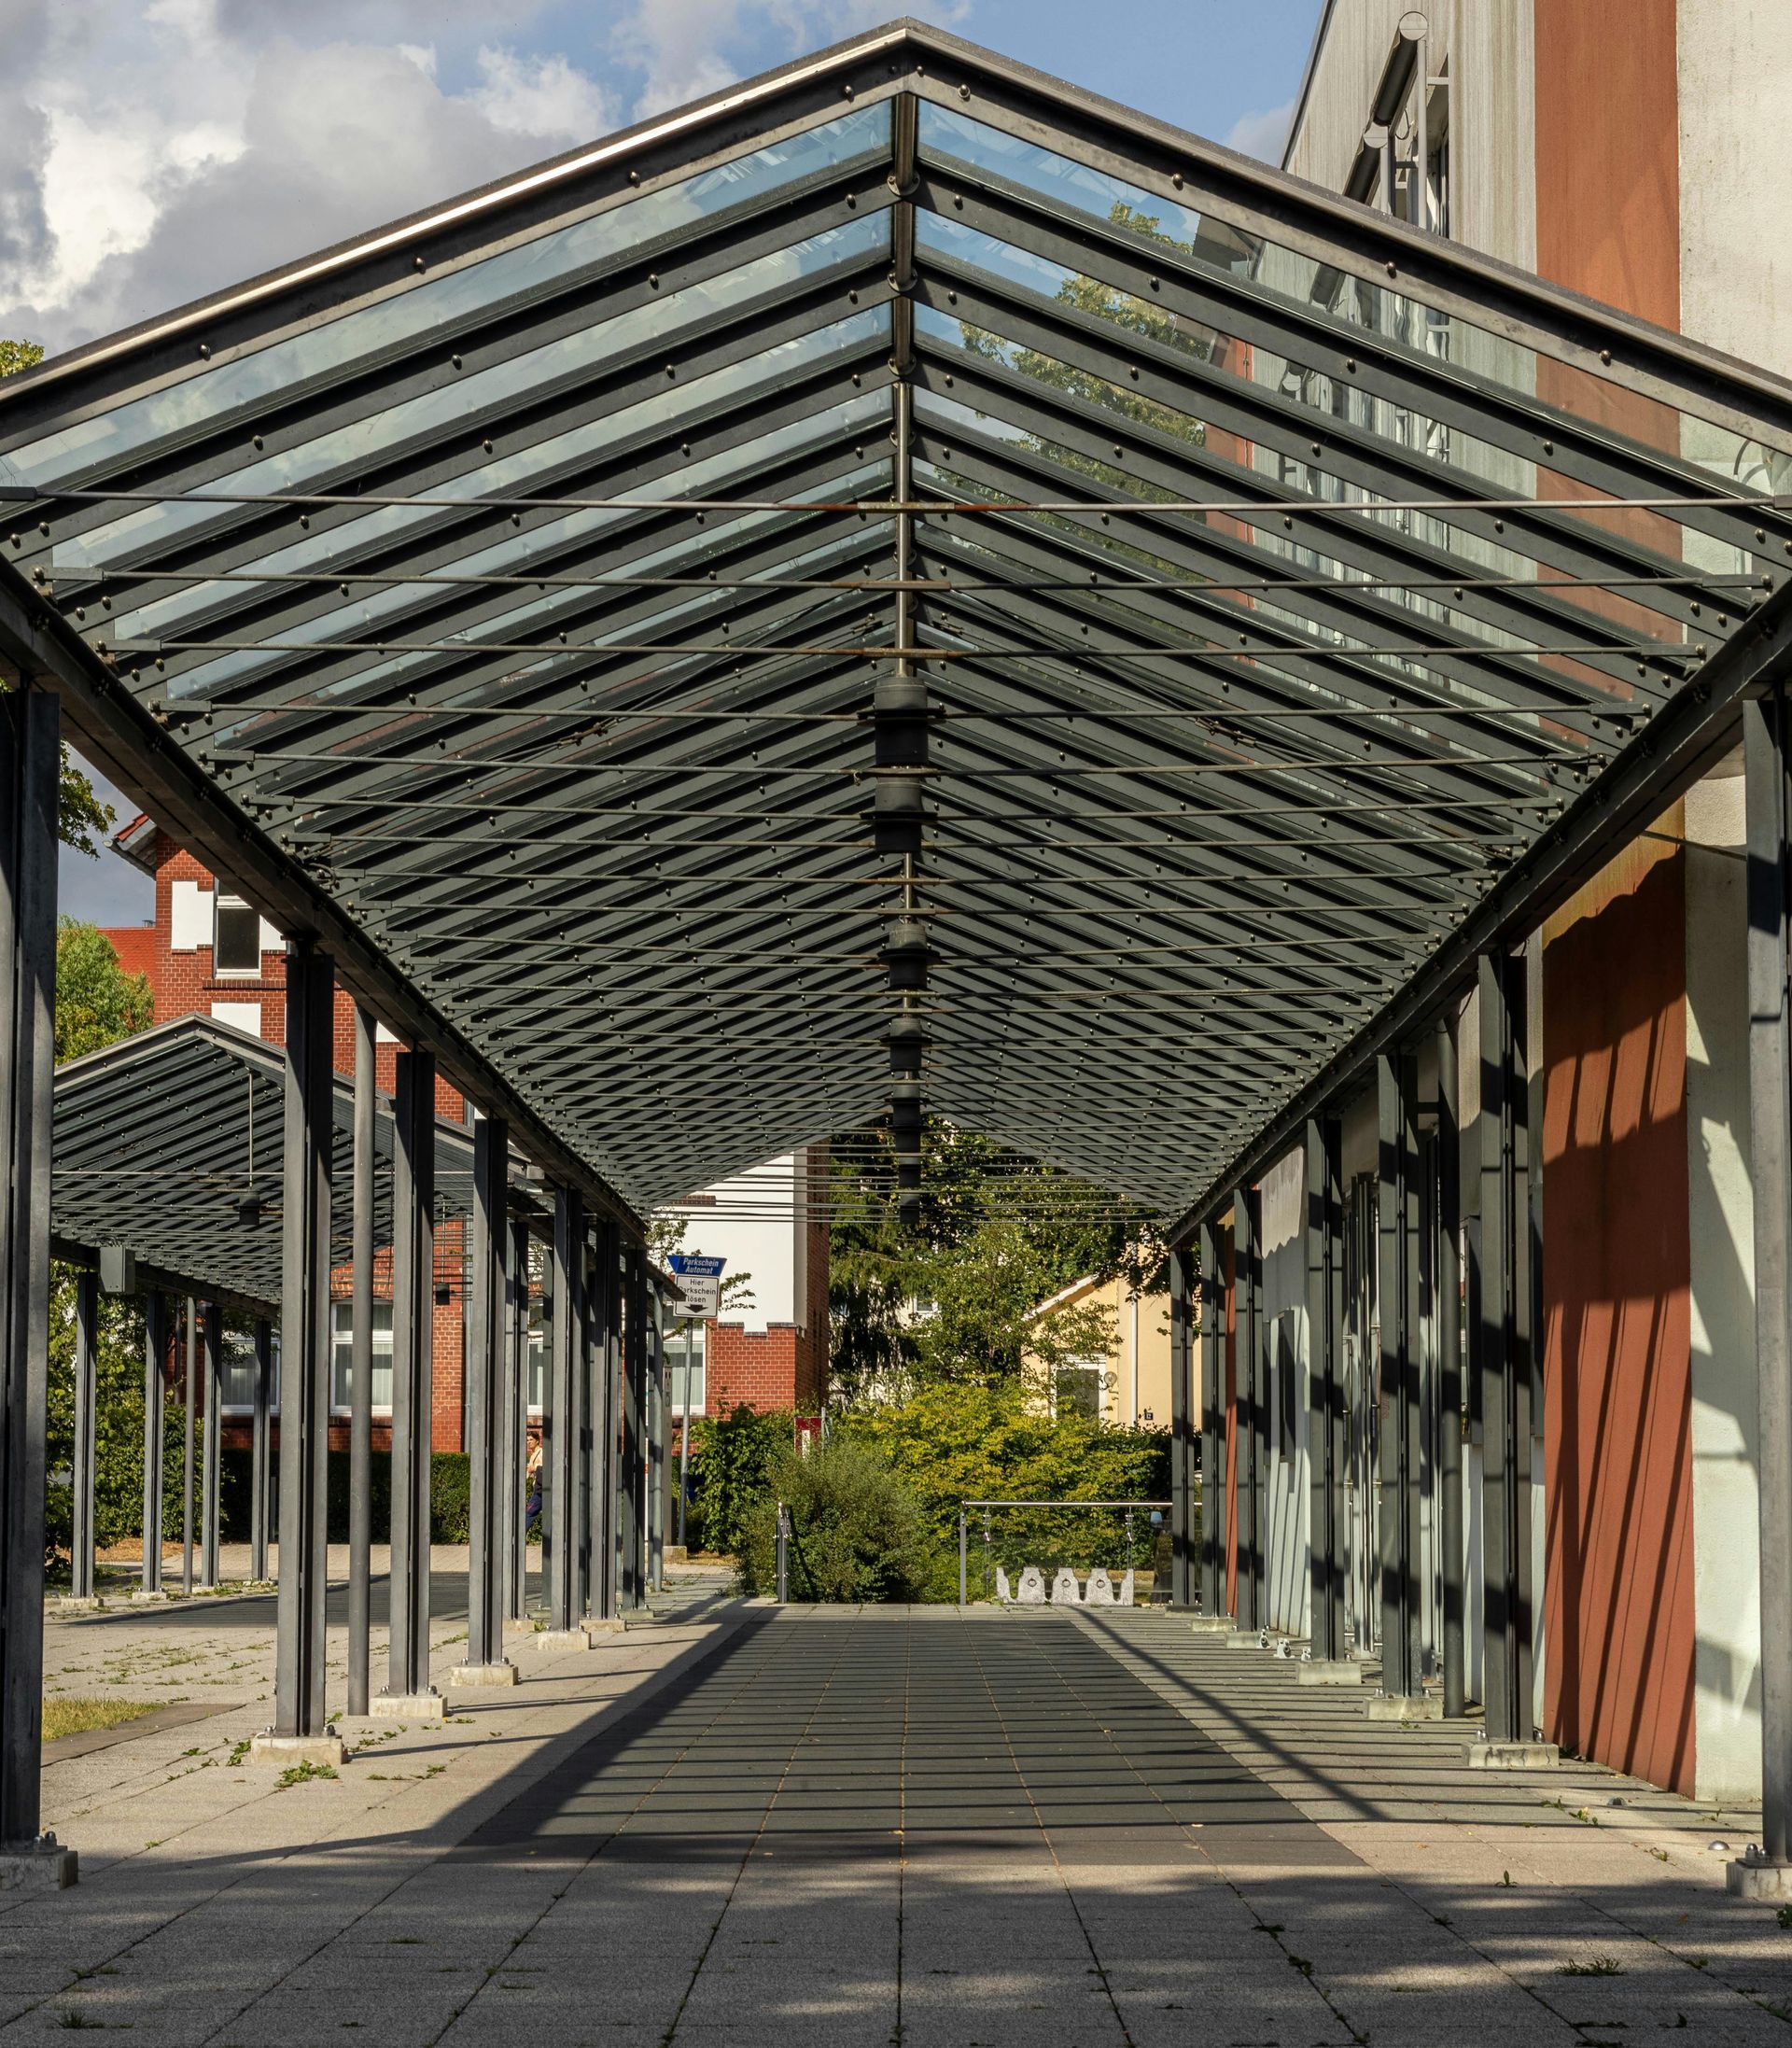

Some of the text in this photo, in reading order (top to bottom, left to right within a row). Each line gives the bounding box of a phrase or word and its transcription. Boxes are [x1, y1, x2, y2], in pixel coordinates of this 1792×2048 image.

[683, 1257, 719, 1268] Parkschein
[685, 1266, 713, 1274] Automat
[690, 1278, 705, 1286] Hier
